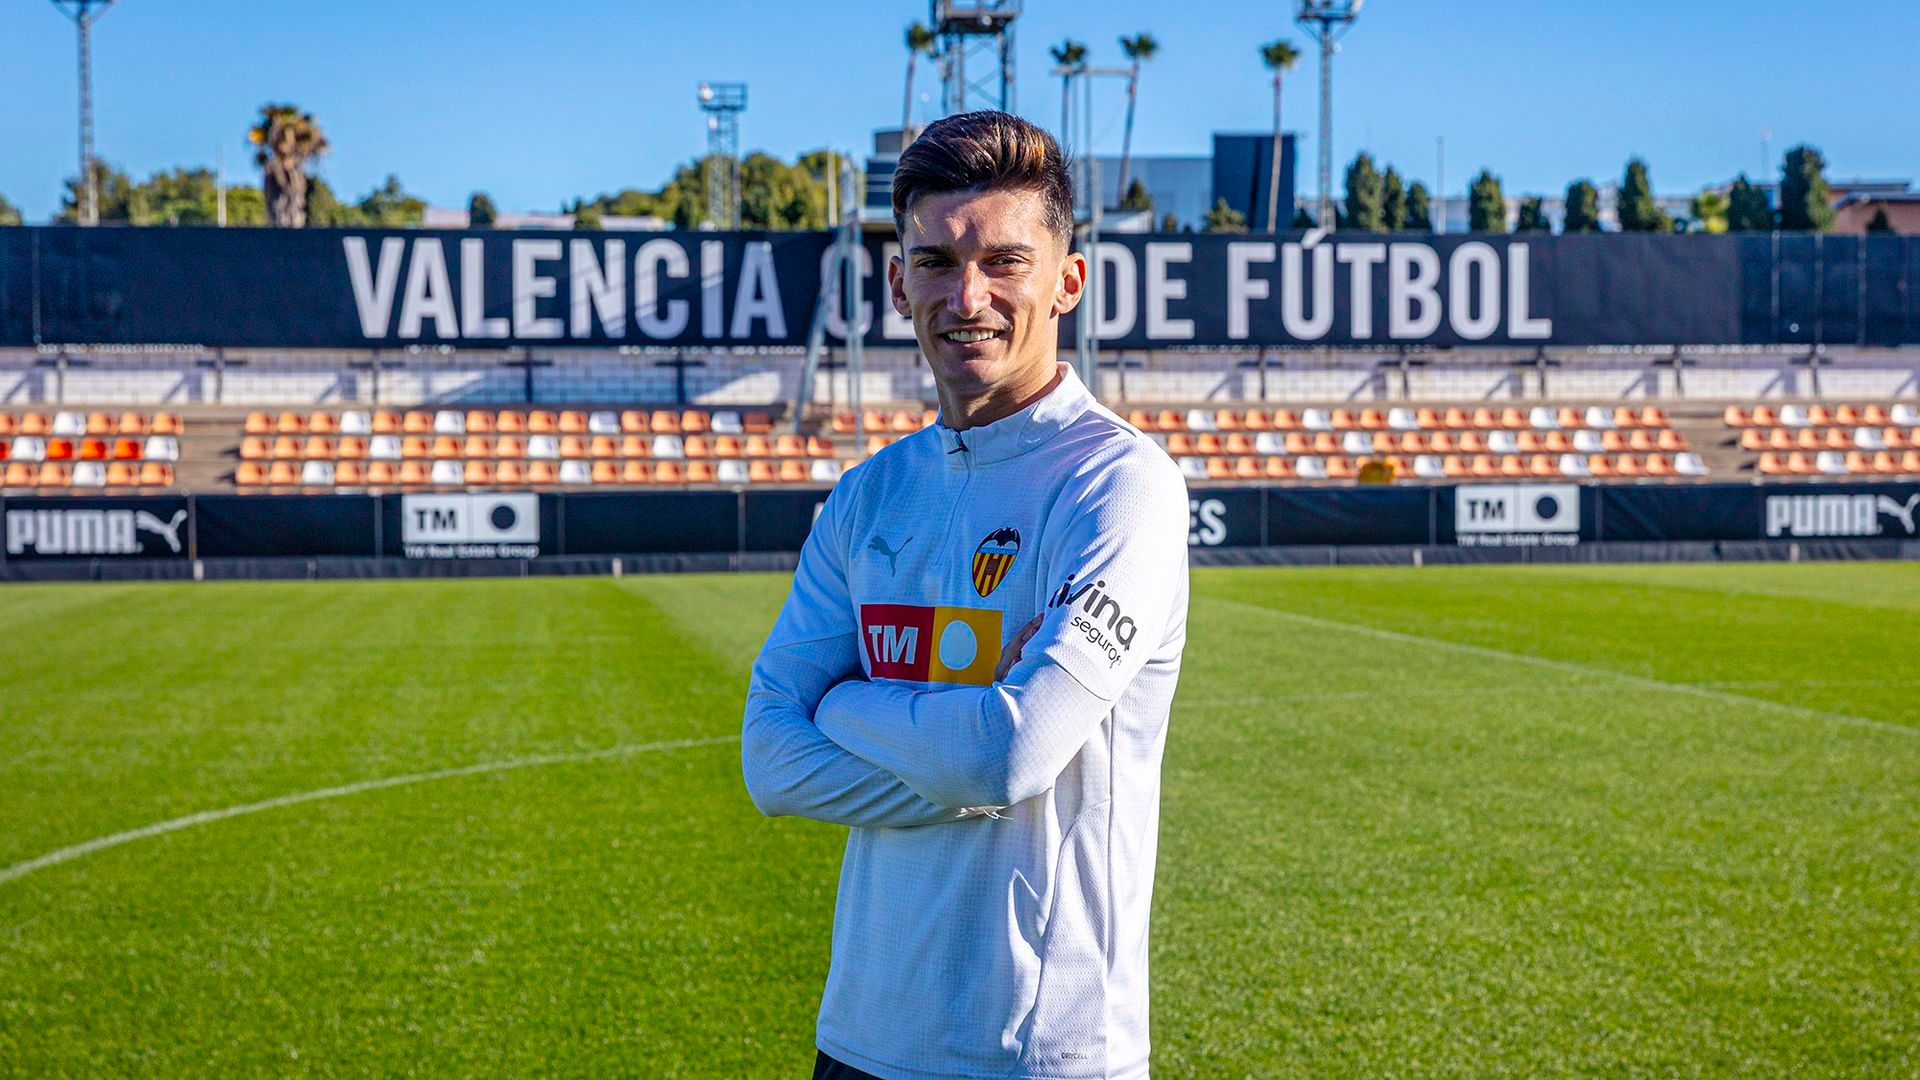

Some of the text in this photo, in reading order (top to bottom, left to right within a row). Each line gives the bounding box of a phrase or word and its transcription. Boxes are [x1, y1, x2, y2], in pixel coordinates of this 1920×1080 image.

[343, 236, 788, 340] VALENCIA
[1085, 241, 1195, 340] DE
[1227, 228, 1553, 341] FÚTBOL
[415, 508, 457, 531] TM
[1467, 499, 1506, 520] TM
[1766, 494, 1878, 536] PUMA
[6, 509, 137, 555] PUMA
[868, 625, 919, 665] TM
